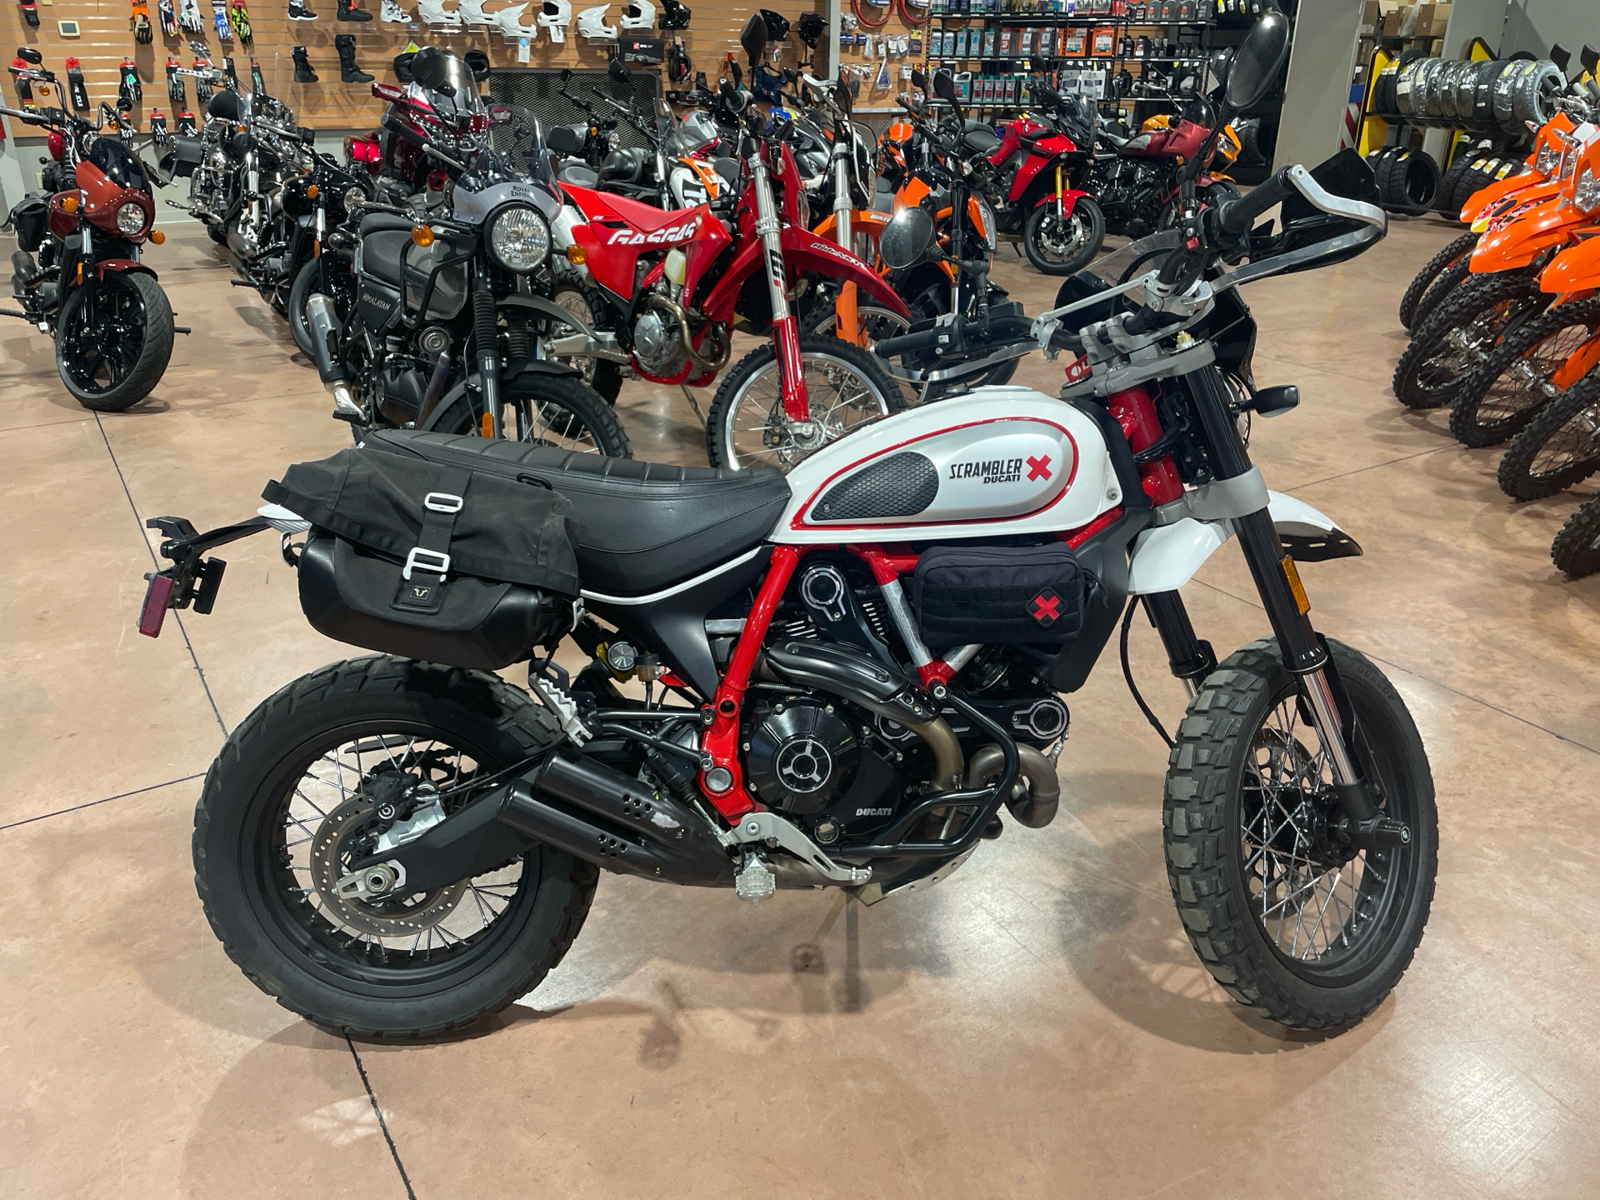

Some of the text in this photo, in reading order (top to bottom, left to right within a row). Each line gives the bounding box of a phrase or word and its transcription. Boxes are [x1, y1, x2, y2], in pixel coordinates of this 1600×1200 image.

[606, 221, 697, 245] GASGAS
[361, 292, 392, 311] HIMALAYAN
[948, 458, 1023, 479] SCRAMBLER
[983, 474, 1021, 484] DUCATI
[855, 807, 893, 817] DUCATI
